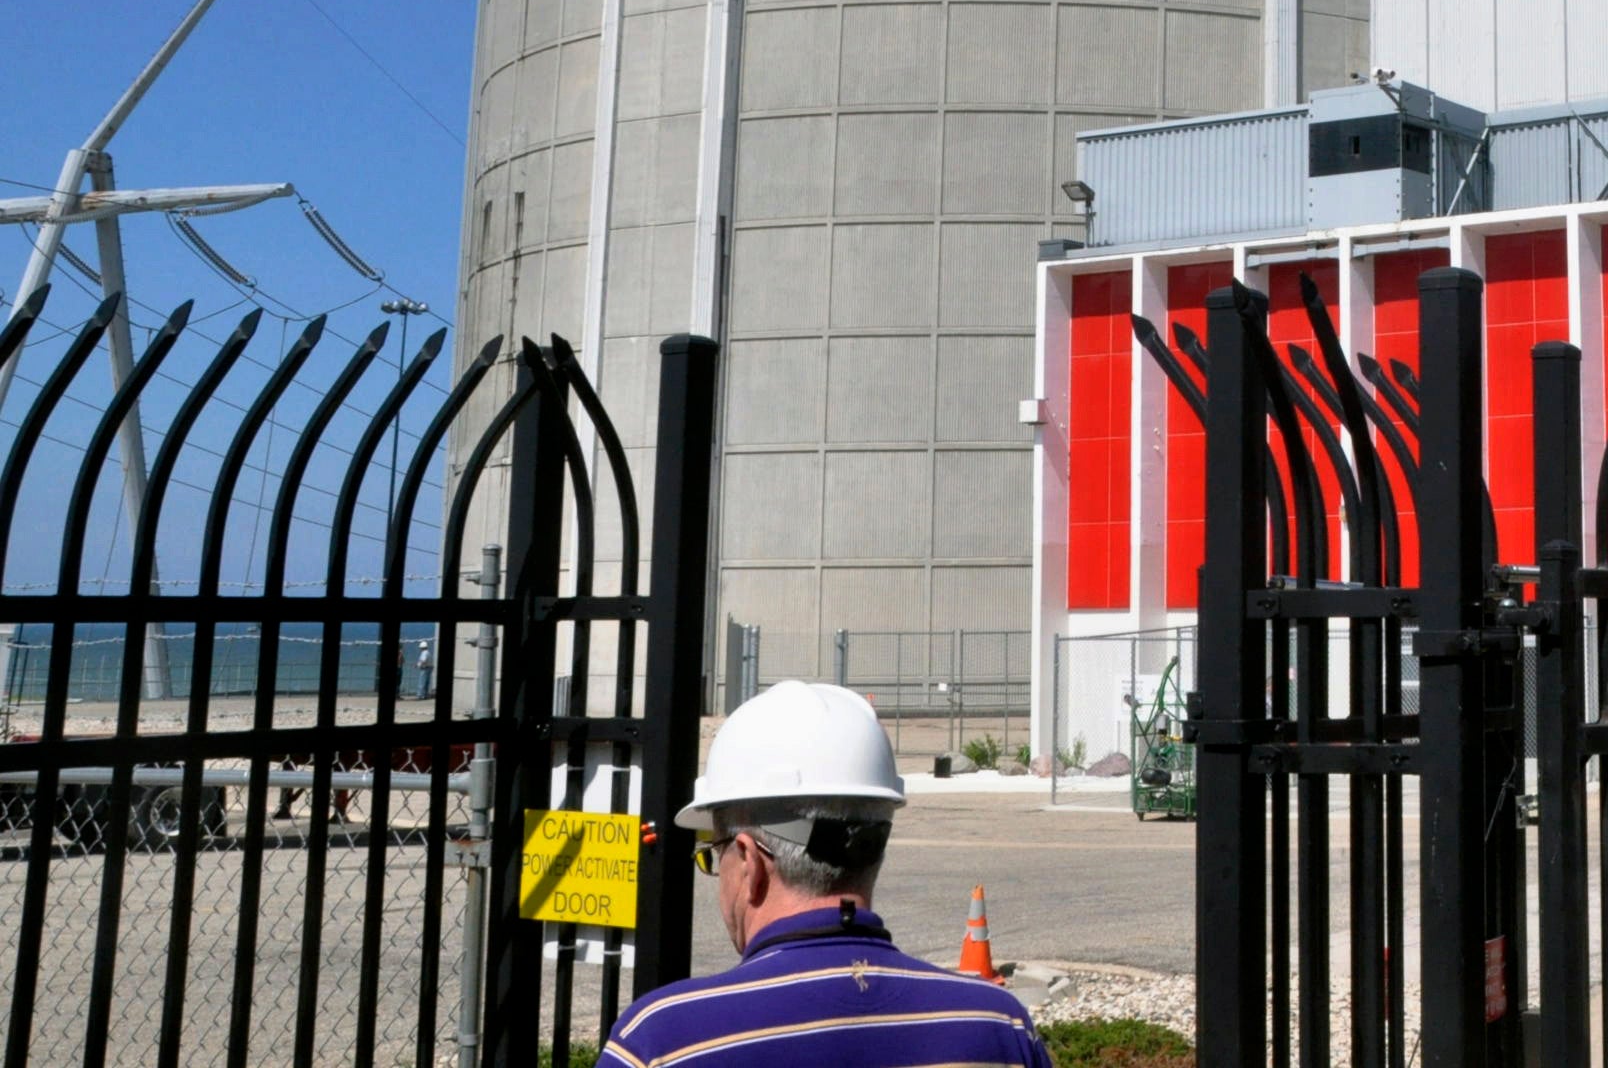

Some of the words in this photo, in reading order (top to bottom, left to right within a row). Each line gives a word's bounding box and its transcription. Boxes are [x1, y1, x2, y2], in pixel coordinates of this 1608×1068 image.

[542, 818, 631, 845] CAUTION
[521, 853, 574, 878] POWER
[574, 856, 637, 883] ACTIVATE
[553, 891, 612, 918] DOOR
